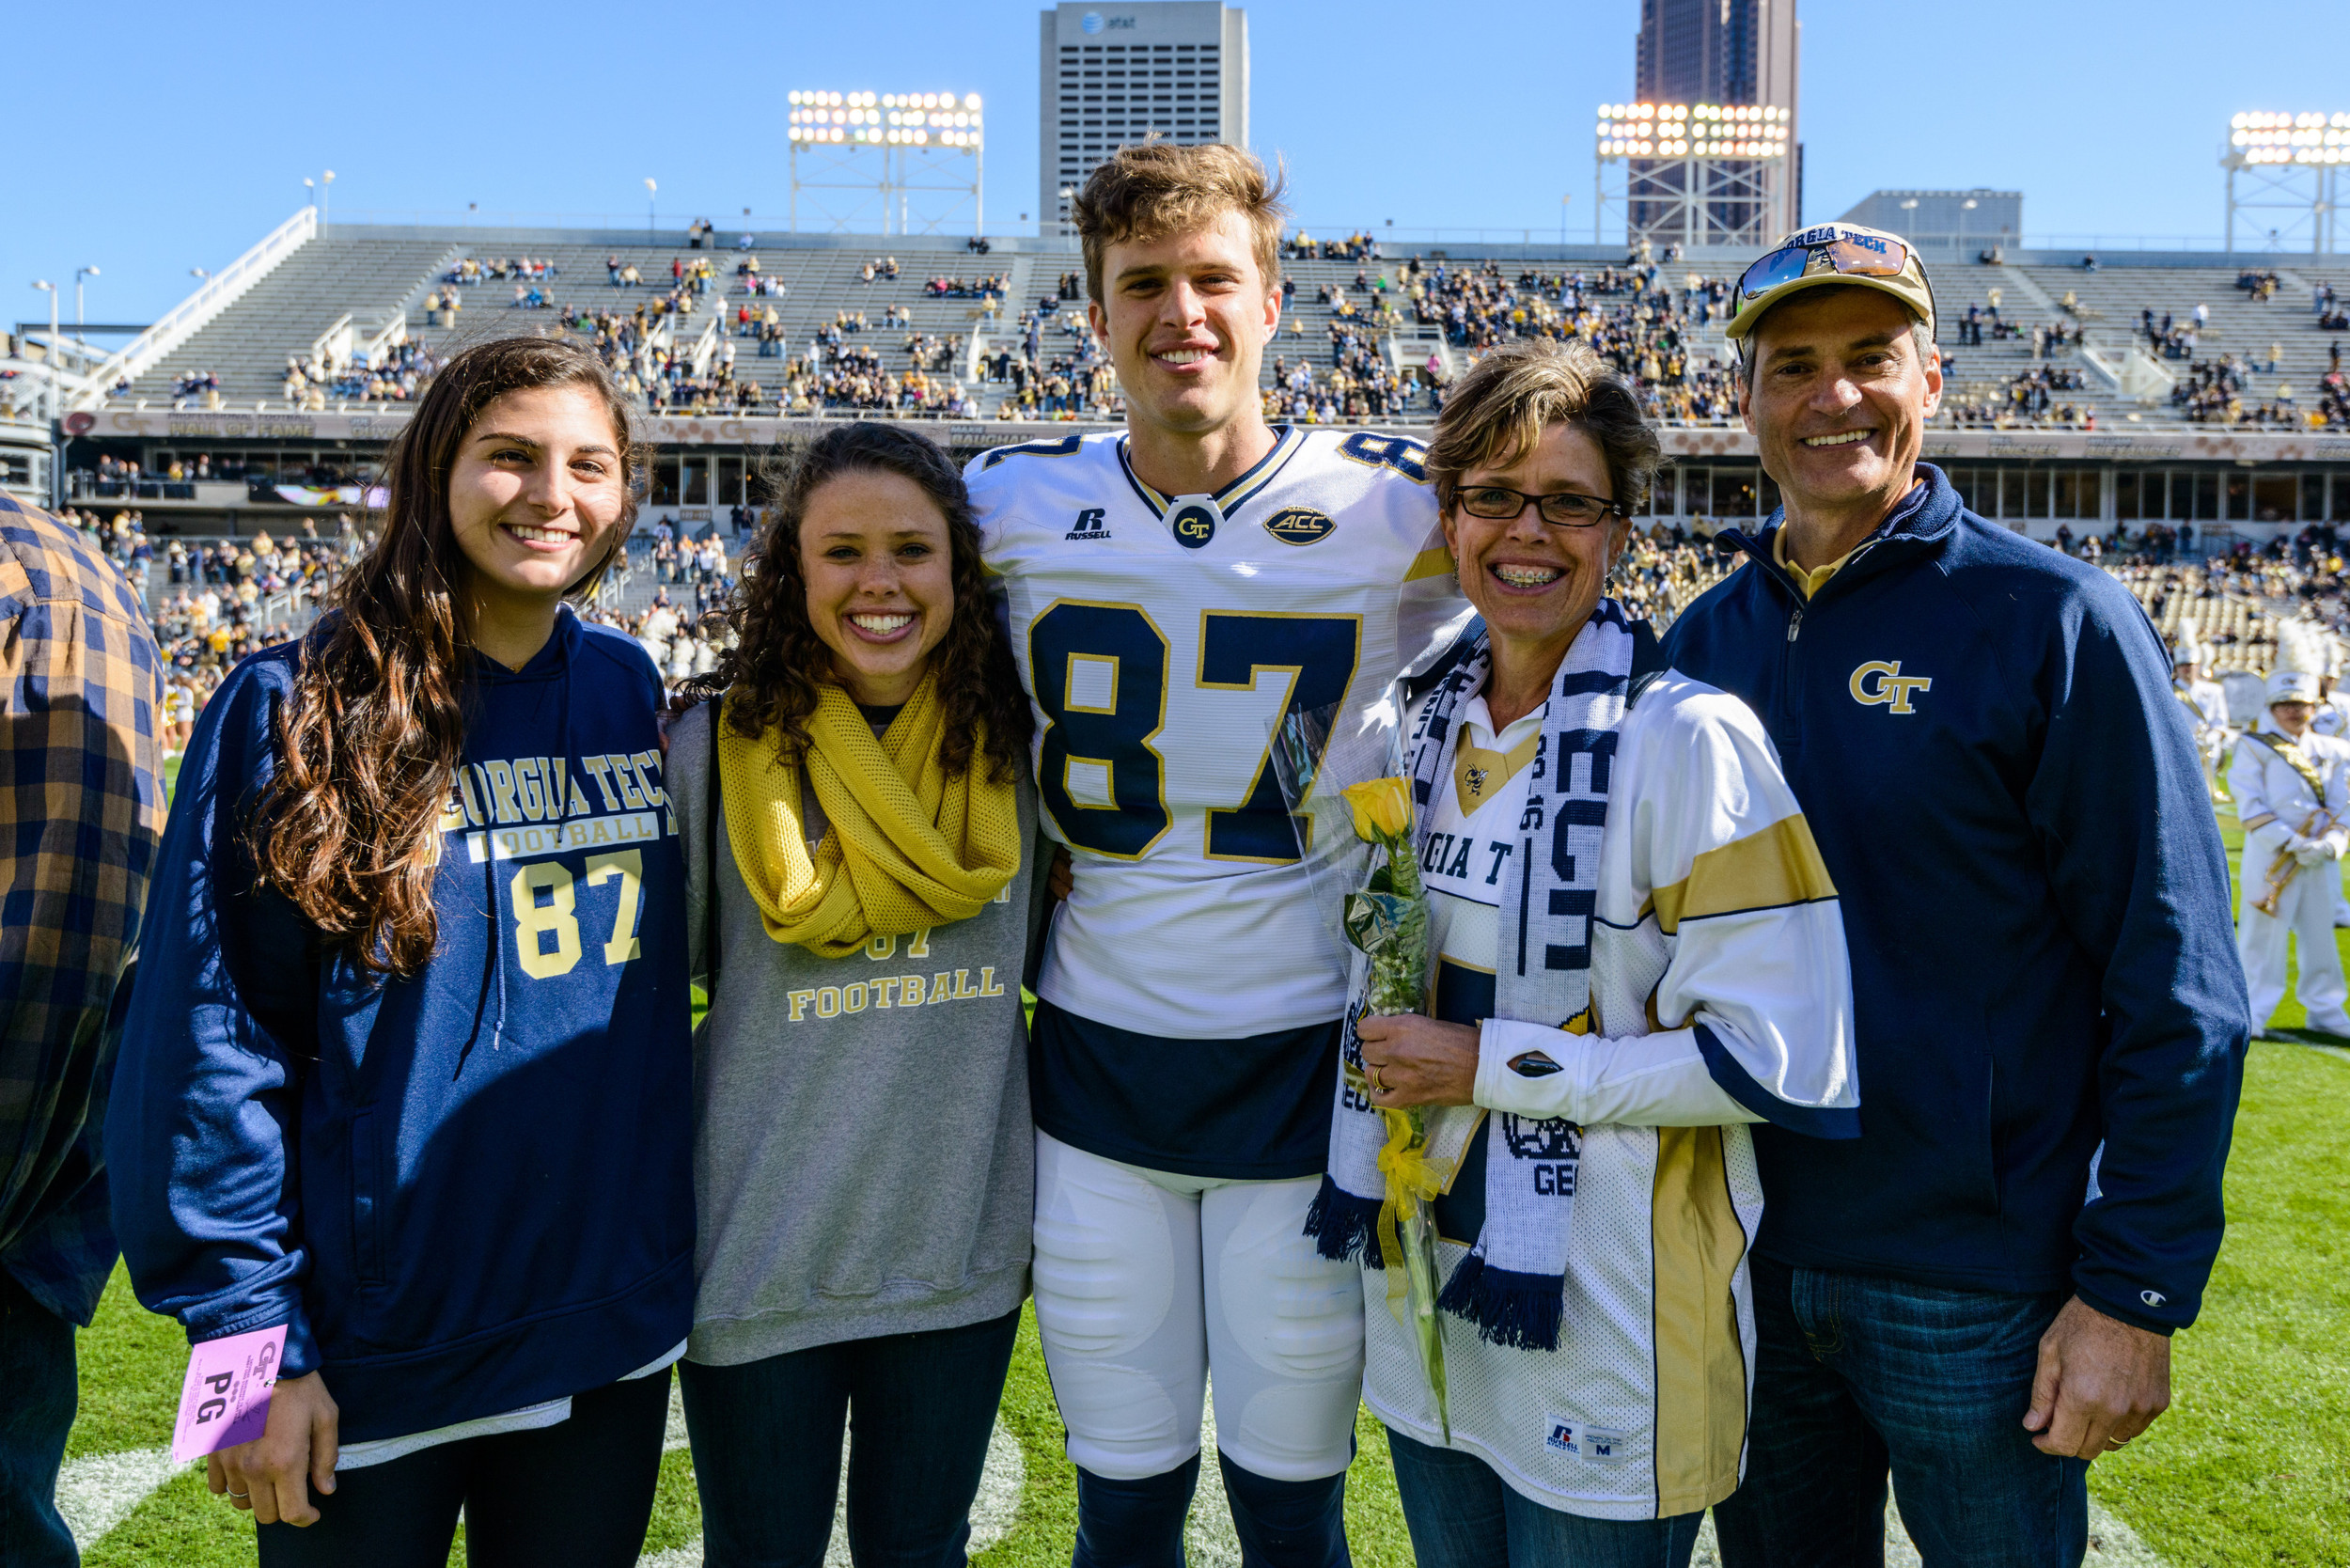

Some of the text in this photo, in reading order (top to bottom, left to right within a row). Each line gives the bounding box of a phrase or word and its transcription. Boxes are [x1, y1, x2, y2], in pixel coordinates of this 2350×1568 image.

[169, 423, 316, 437] HALL OF FAME
[950, 425, 985, 434] MAXIE
[1178, 517, 1210, 539] GT
[1274, 514, 1326, 529] ACC
[1065, 530, 1111, 541] RUSSELL
[1849, 660, 1933, 714] GT
[1027, 597, 1364, 866] 87
[510, 848, 643, 980] 87
[787, 966, 1005, 1022] FOOTBALL
[1534, 1164, 1578, 1197] GE
[196, 1370, 234, 1425] PG
[1546, 1441, 1579, 1454] ATHLETIC
[1547, 1435, 1579, 1450] RUSSELL
[1596, 1445, 1611, 1456] M
